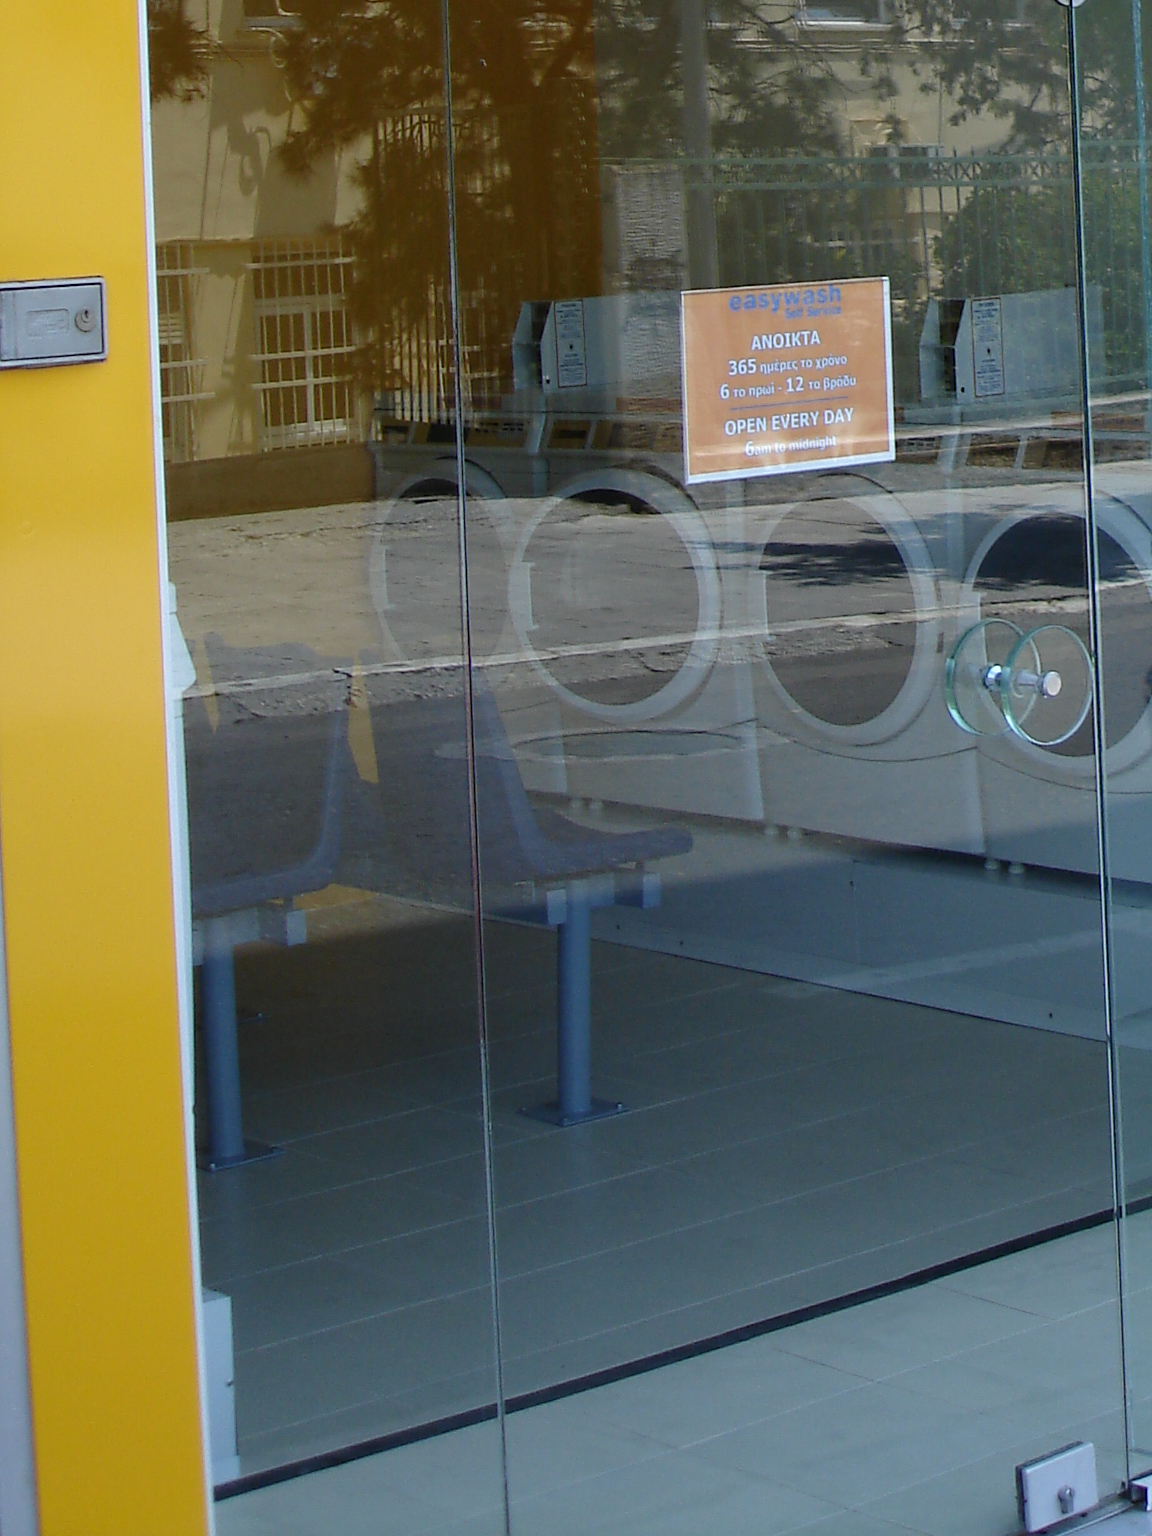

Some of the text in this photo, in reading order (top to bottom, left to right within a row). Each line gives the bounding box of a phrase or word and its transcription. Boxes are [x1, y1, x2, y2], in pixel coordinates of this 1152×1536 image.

[728, 283, 842, 313] easywash
[751, 330, 821, 351] ΑΝΟΙΚΤΑ
[728, 354, 848, 376] 365 ημέρες το χρόνο
[720, 384, 730, 400] 6
[733, 388, 746, 398] το
[786, 377, 805, 393] 12
[808, 380, 821, 390] το
[823, 375, 857, 392] βράδυ
[725, 407, 854, 435] OPEN EVERY DAY
[745, 435, 837, 457] 6am to midnight
